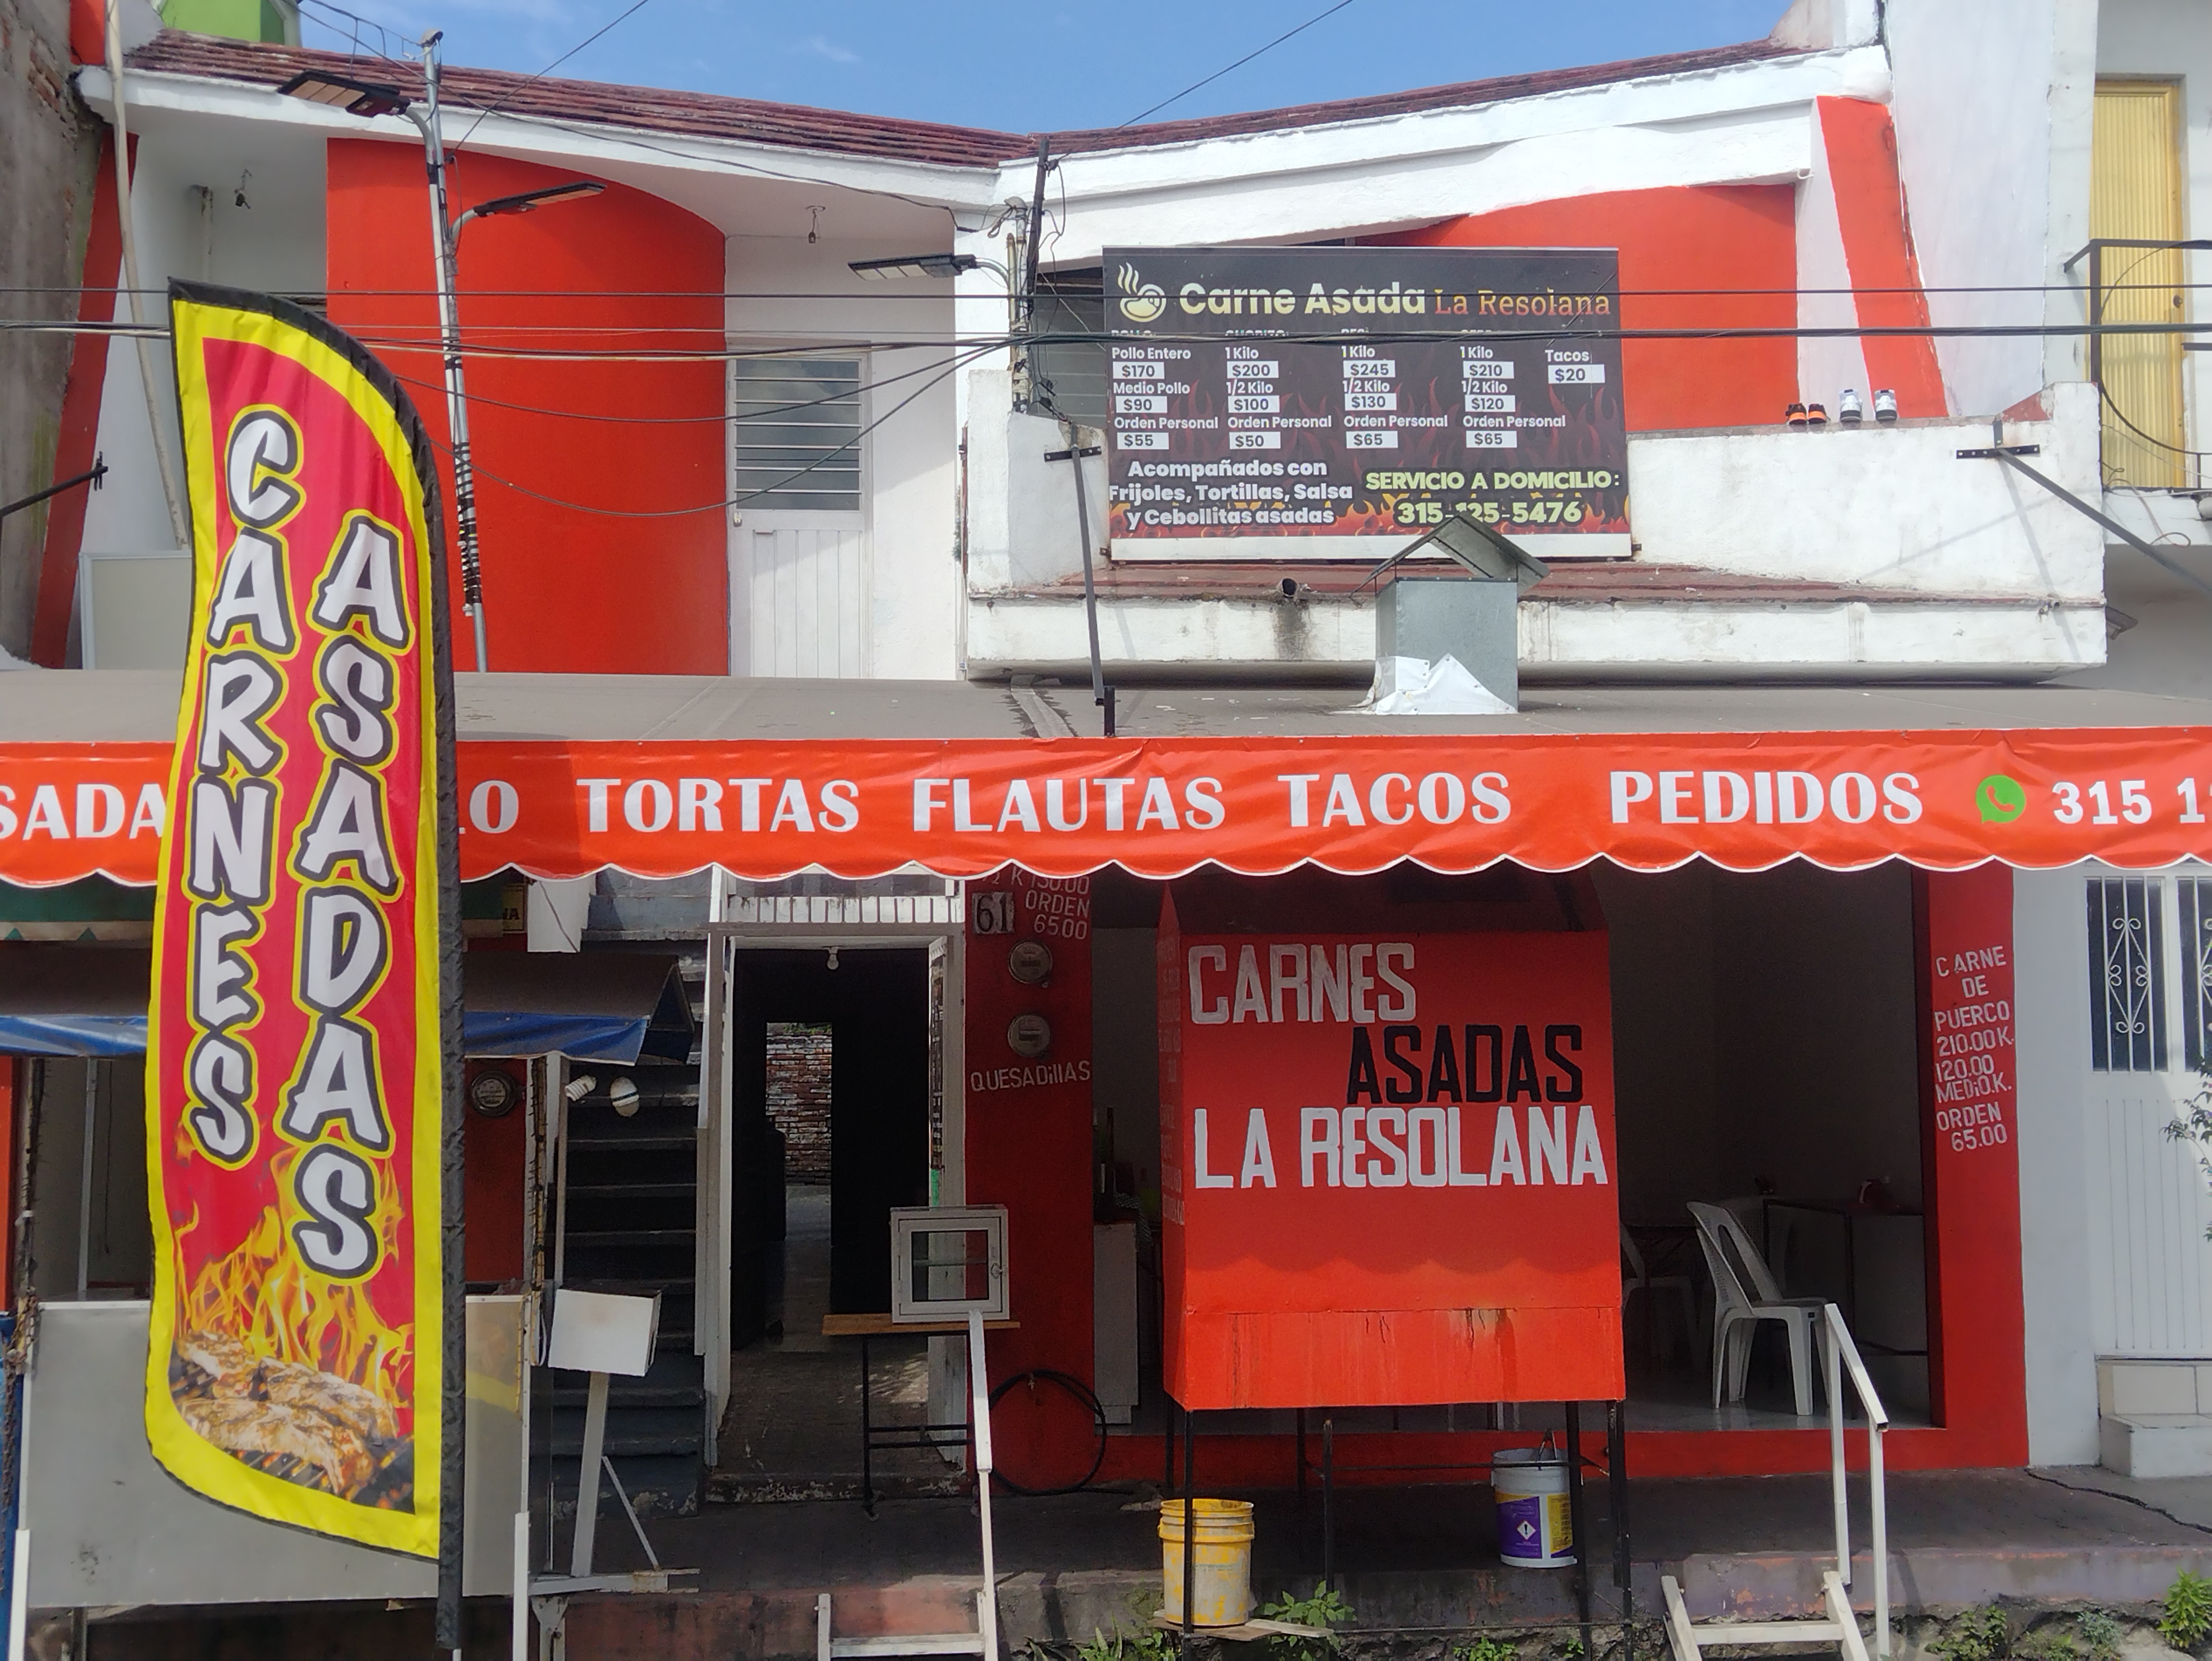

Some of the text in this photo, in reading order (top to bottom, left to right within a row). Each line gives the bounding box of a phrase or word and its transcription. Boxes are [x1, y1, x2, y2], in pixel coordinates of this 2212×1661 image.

[1180, 281, 1611, 316] Carne Asada La Resolana
[1112, 347, 1191, 360] Pollo Entero
[1225, 347, 1259, 360] 1 Kilo
[1341, 345, 1375, 358] 1 Kilo
[1460, 346, 1493, 359] 1 Kilo
[1545, 349, 1590, 362] Tacos
[1122, 364, 1155, 378] $170
[1232, 363, 1271, 377] $200
[1350, 362, 1389, 376] $245
[1469, 364, 1503, 377] $210
[1554, 367, 1586, 383] $20
[1113, 381, 1190, 394] Medio Pollo
[1226, 381, 1273, 396] 1/2 Kilo
[1342, 378, 1390, 394] 1/2 Kilo
[1461, 378, 1507, 394] 1/2 Kilo
[1123, 398, 1152, 412] $90
[1233, 398, 1269, 411] $100
[1351, 395, 1386, 409] $130
[1471, 397, 1504, 411] $120
[1114, 417, 1218, 430] Orden Personal
[1228, 416, 1331, 429] Orden Personal
[1344, 415, 1448, 428] Orden Personal
[1463, 415, 1566, 428] Orden Personal
[1124, 434, 1154, 447] $55
[1235, 434, 1265, 448] $50
[1353, 432, 1383, 446] $65
[1474, 432, 1503, 445] $65
[1128, 459, 1327, 481] Acompañados con
[1366, 470, 1620, 490] SERVICIO A DOMICILIO:
[1109, 483, 1353, 505] Frijoles, Tortillas, Salsa
[1126, 507, 1335, 530] y Cebollitas asadas
[190, 410, 302, 1163] CARNES
[576, 777, 860, 833] TORTAS
[913, 776, 1226, 832] FLAUTAS
[1278, 772, 1512, 828] TACOS
[1610, 771, 1923, 824] PEDIDOS
[2052, 779, 2152, 825] 315
[2177, 778, 2212, 824] 1
[282, 516, 409, 1278] ASADAS
[1025, 889, 1090, 918] ORDEN
[976, 895, 1008, 932] 61
[1034, 914, 1087, 940] 65.00
[1188, 943, 1417, 1025] CARNES
[1962, 974, 1989, 998] DE
[1935, 1000, 2010, 1031] PUERCO
[1347, 1024, 1585, 1104] ASADAS
[1936, 1054, 1994, 1082] 120.00
[1936, 1102, 2002, 1131] ORDEN
[1951, 1123, 2008, 1152] 65.00
[1193, 1105, 1609, 1189] LA RESOLANA
